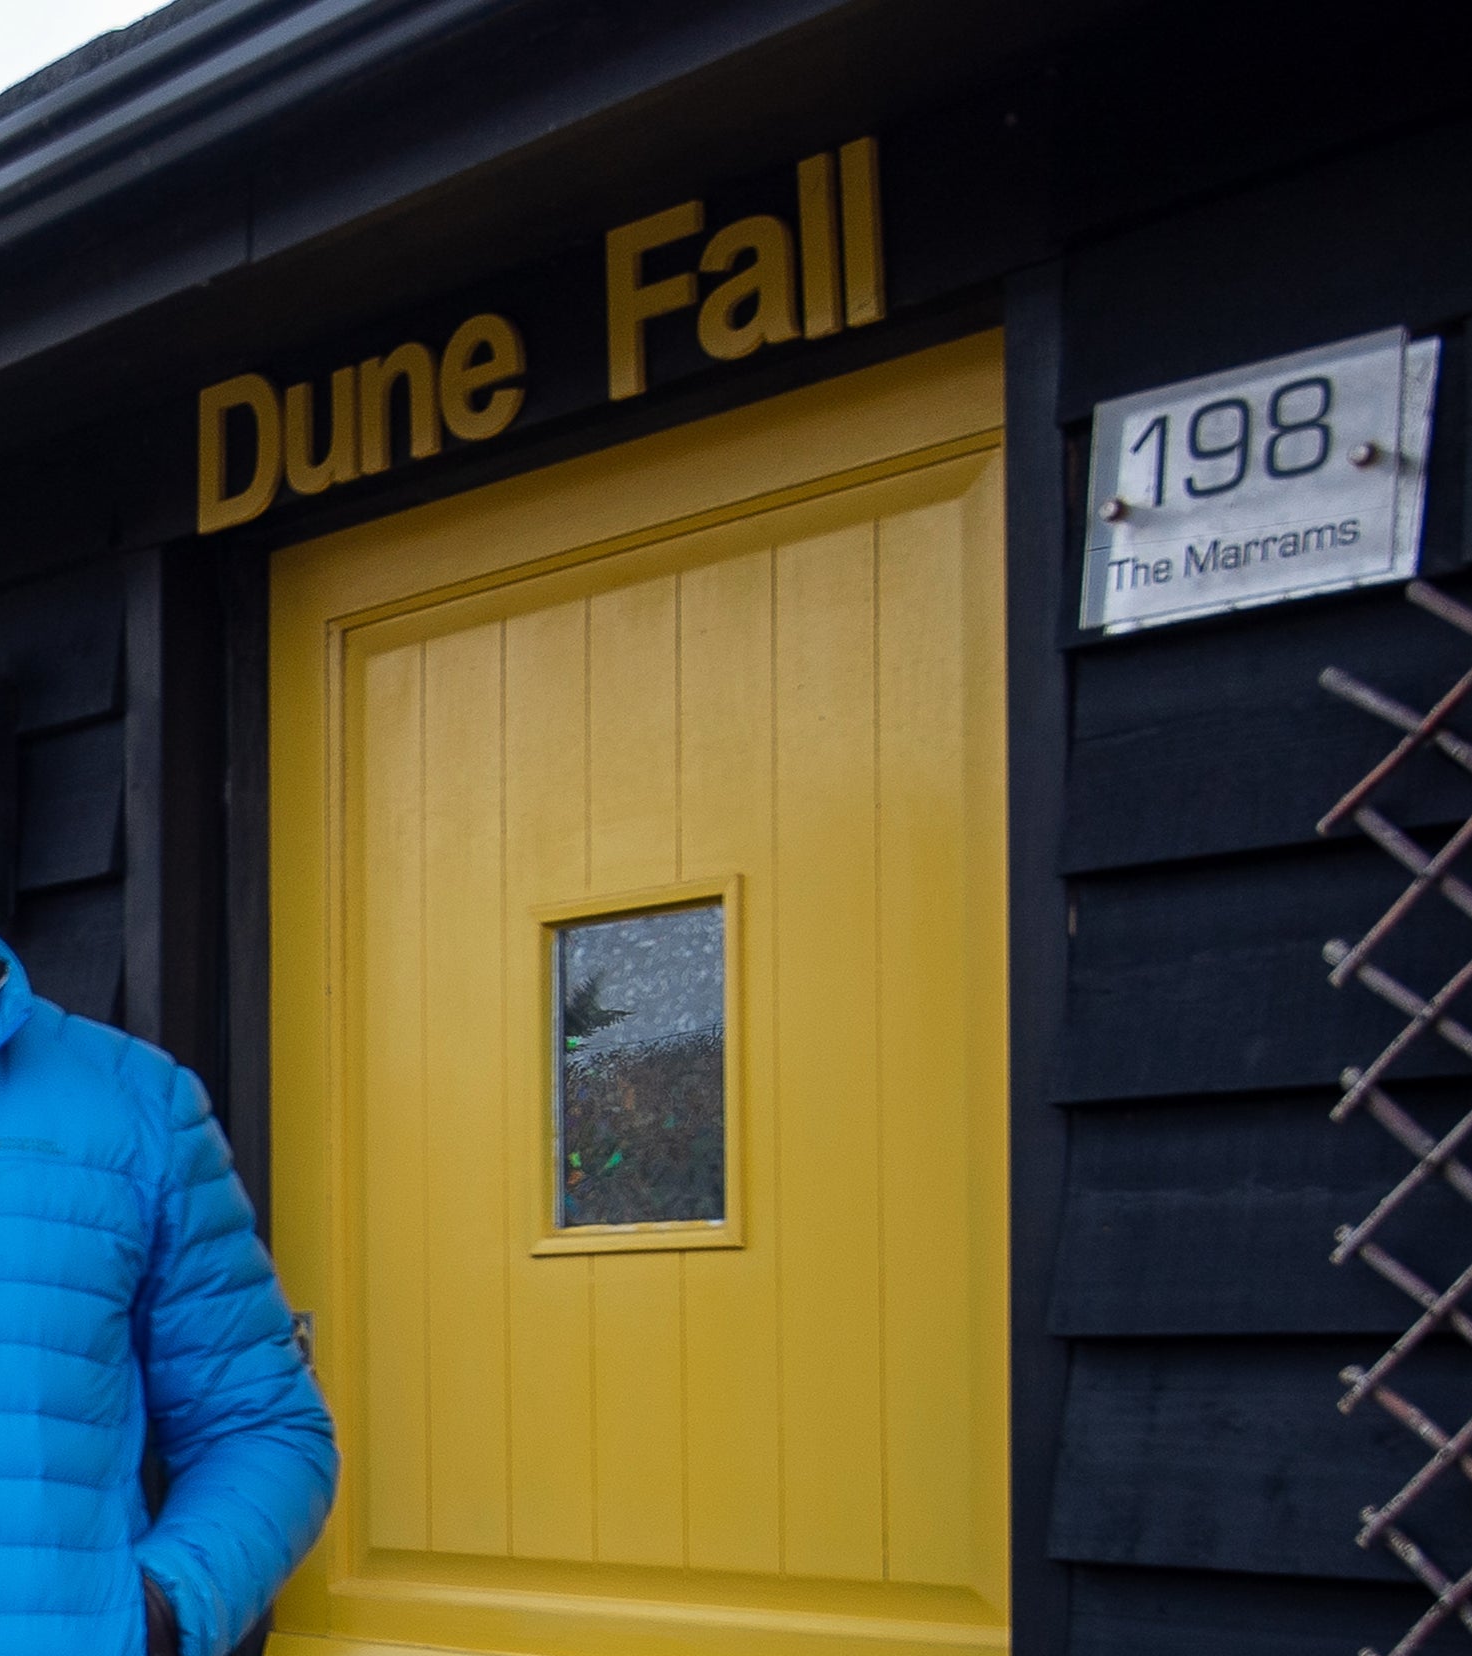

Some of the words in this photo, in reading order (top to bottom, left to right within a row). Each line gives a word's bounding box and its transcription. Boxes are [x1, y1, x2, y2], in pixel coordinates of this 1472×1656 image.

[197, 312, 526, 535] Dune
[605, 136, 886, 401] Fall
[1130, 375, 1334, 508] 198
[1109, 554, 1173, 593] The
[1183, 517, 1361, 578] Marrams
